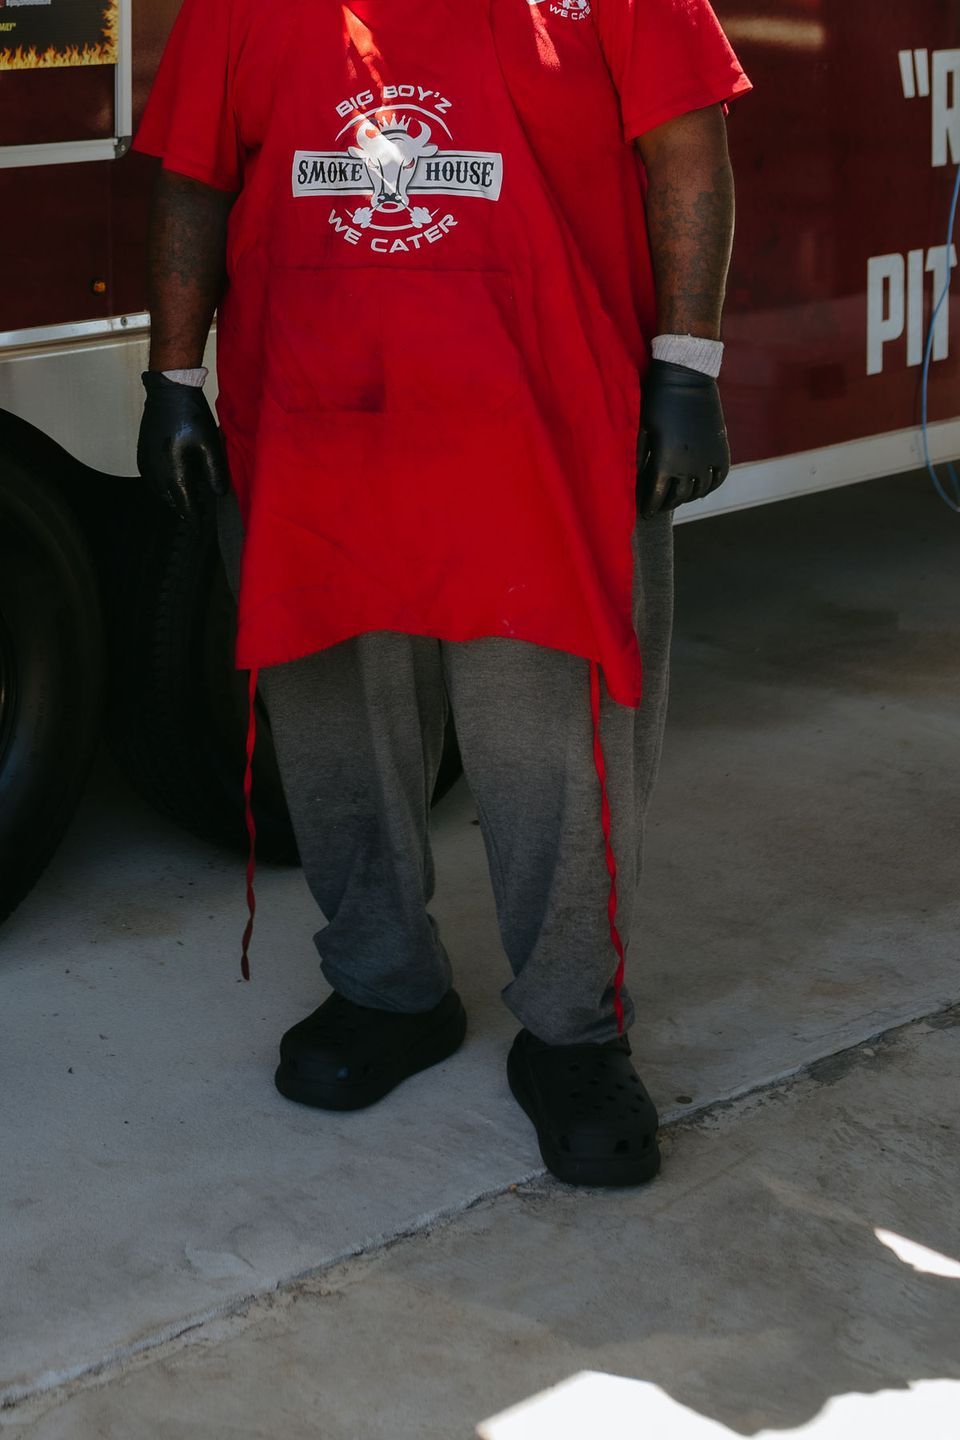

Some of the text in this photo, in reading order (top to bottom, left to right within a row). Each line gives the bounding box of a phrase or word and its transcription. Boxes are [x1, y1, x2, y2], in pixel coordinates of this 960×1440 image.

[550, 4, 568, 17] WE
[335, 85, 452, 117] BIG BOY'Z
[297, 160, 494, 187] SMOKE HOUSE
[328, 209, 458, 253] WE CATER
